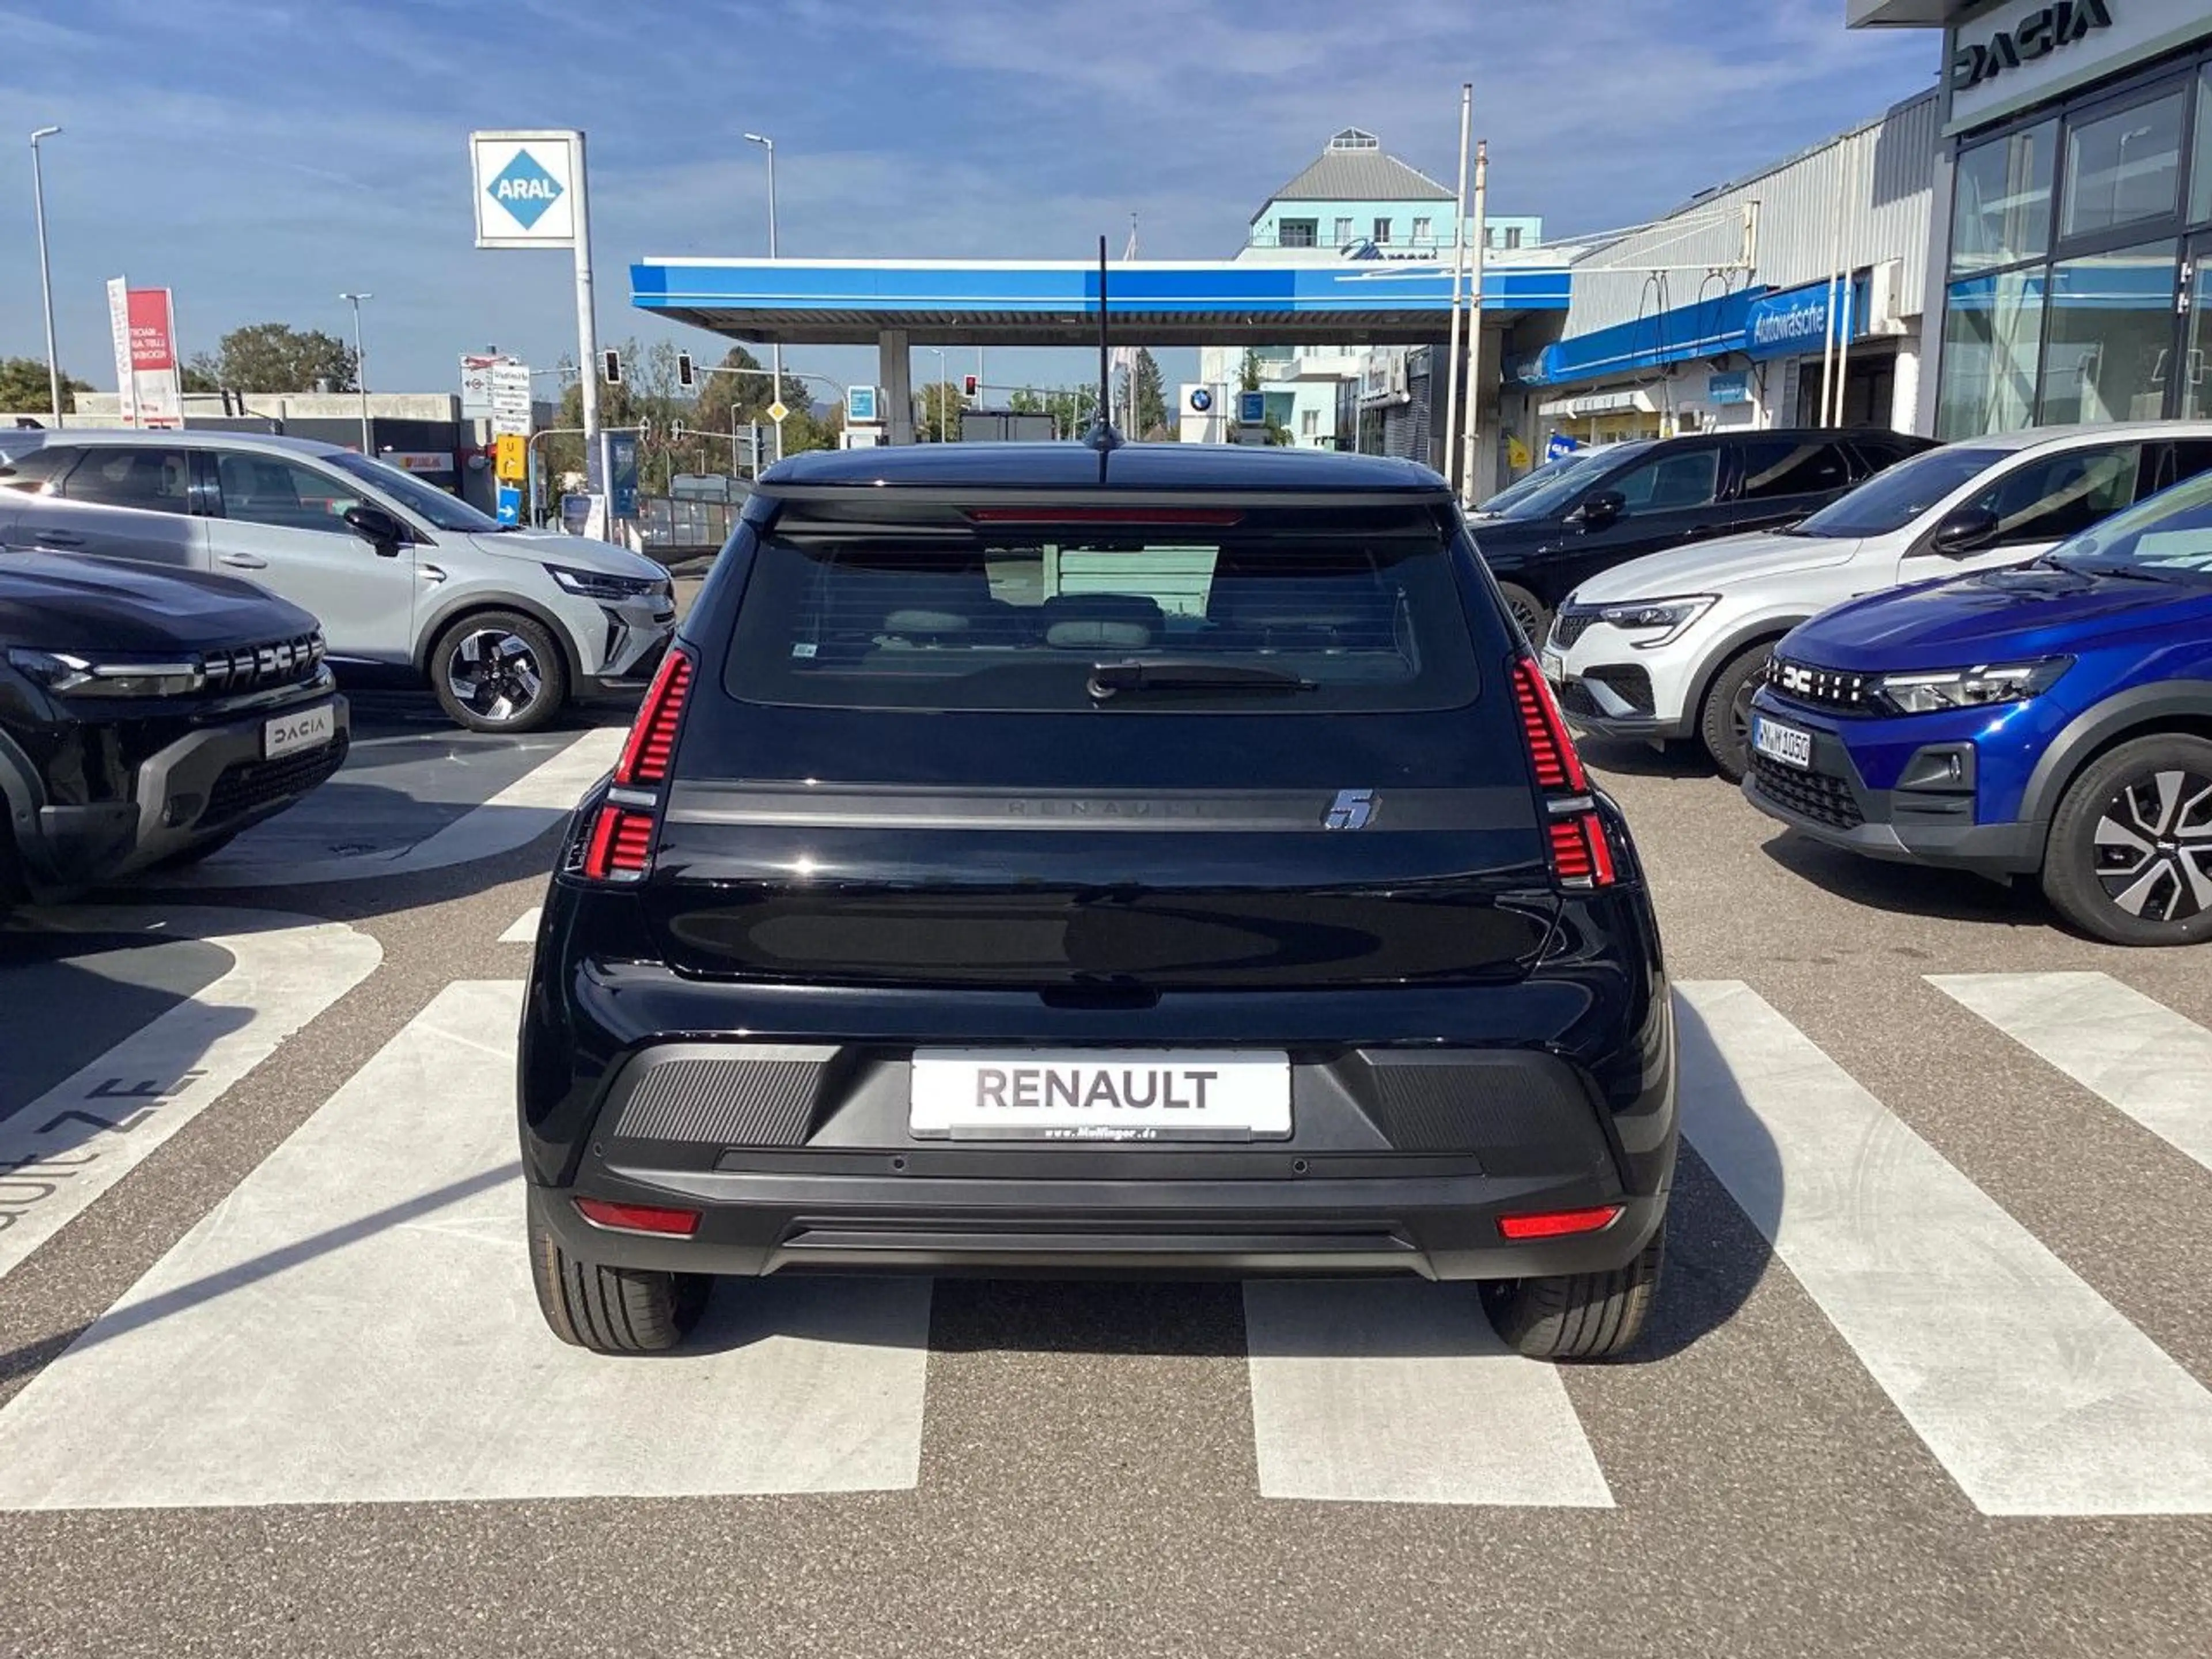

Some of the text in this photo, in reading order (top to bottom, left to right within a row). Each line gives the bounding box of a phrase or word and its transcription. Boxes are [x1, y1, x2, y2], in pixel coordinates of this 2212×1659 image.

[1950, 0, 2113, 90] DACIA
[498, 178, 556, 200] ARAL
[1754, 300, 1825, 344] Autowäsche
[275, 717, 324, 744] DACIA
[1009, 801, 1205, 816] RENAULT
[976, 1069, 1218, 1109] RENAULT
